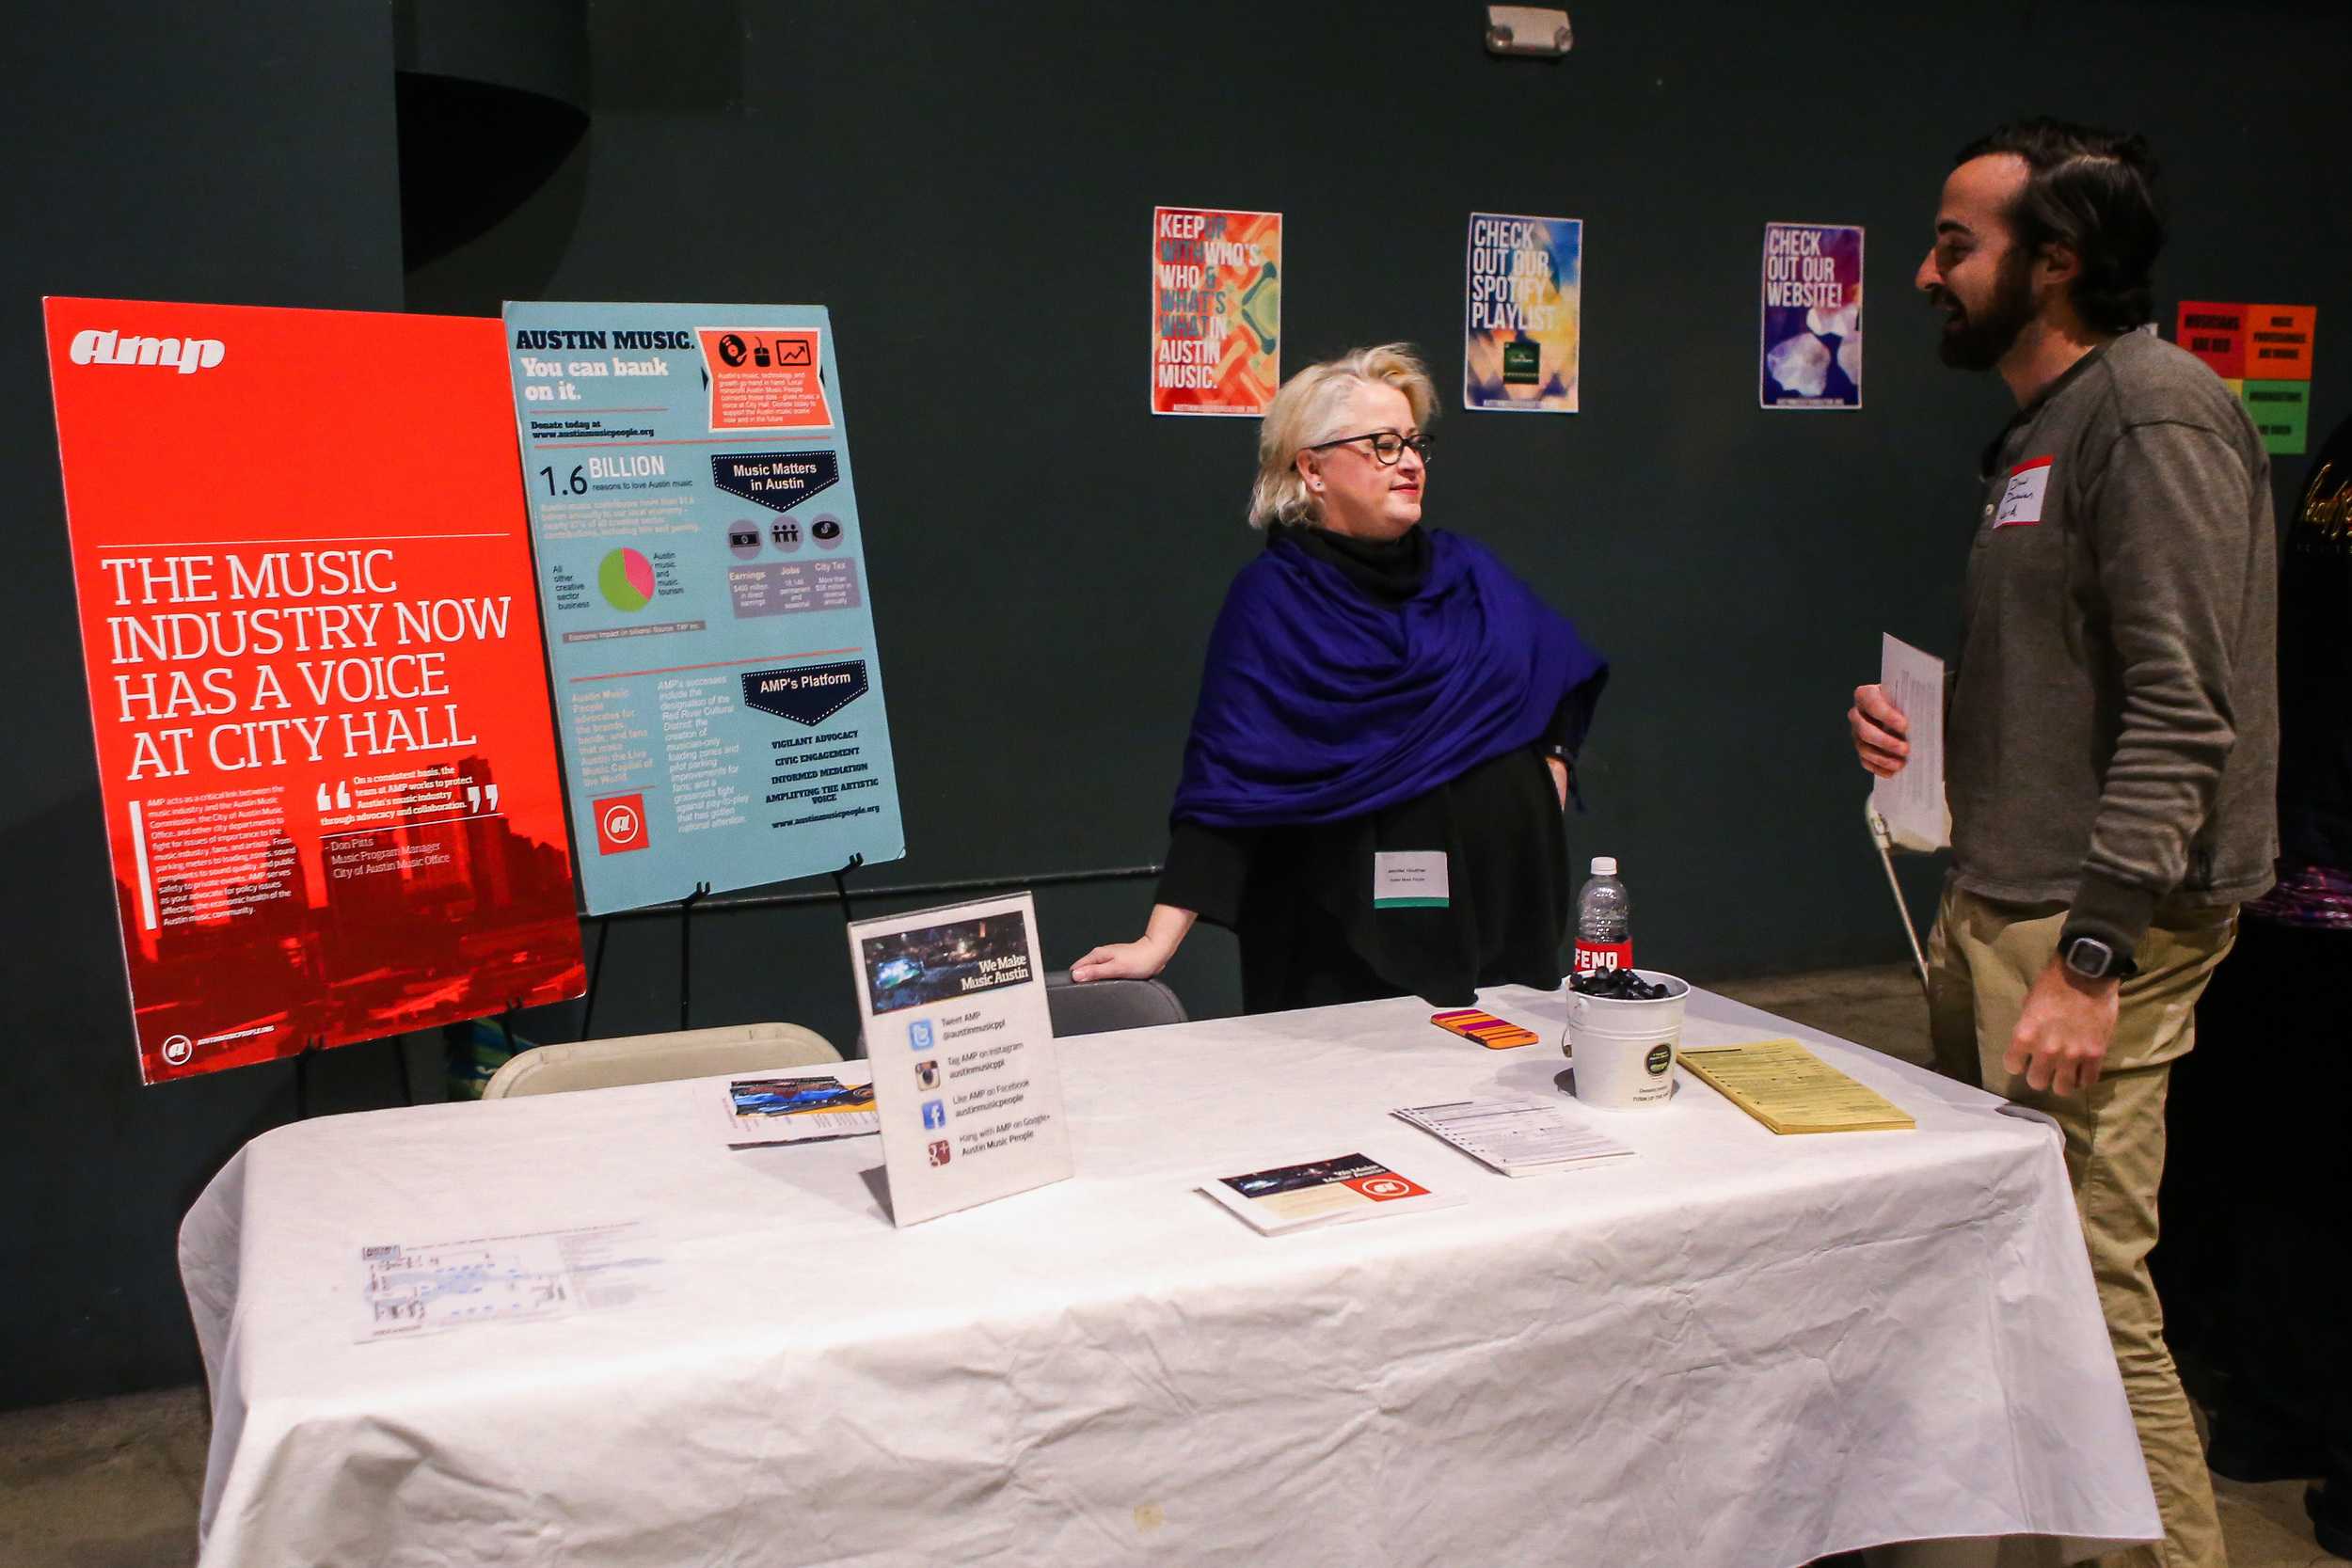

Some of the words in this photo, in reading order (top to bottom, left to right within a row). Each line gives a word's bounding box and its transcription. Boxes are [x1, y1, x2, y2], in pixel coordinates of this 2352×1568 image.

[1160, 214, 1204, 238] KEEP
[1205, 217, 1227, 235] UP
[1474, 220, 1535, 249] CHECK
[1161, 241, 1204, 263] WITH
[1205, 242, 1263, 267] WHO'S
[1769, 230, 1822, 256] CHECK
[1473, 247, 1508, 275] OUT
[1513, 251, 1550, 276] OUR
[1767, 257, 1799, 281] OUT
[1803, 257, 1835, 281] OUR
[1159, 265, 1200, 288] WHO
[1472, 276, 1546, 302] SPOTIFY
[1767, 283, 1842, 308] WEBSITE!
[1160, 290, 1226, 313] WHAT'S
[1160, 315, 1208, 337] WHAT
[1210, 317, 1228, 339] IN
[1472, 302, 1555, 331] PLAYLIST
[516, 330, 607, 349] AUSTIN
[613, 331, 694, 349] MUSIC.
[70, 329, 226, 374] amp
[1159, 341, 1220, 364] AUSTIN
[520, 357, 563, 377] You
[567, 361, 608, 377] can
[613, 357, 668, 377] bank
[1159, 364, 1217, 388] MUSIC.
[525, 384, 553, 401] on
[558, 381, 581, 401] it.
[531, 420, 562, 429] Donate
[564, 420, 591, 430] today
[540, 465, 587, 496] 1.6
[589, 455, 665, 478] BILLION
[733, 463, 770, 476] Music
[772, 461, 817, 475] Matters
[751, 478, 762, 490] in
[766, 477, 804, 490] Austin
[103, 557, 217, 606] THE
[226, 549, 397, 601] MUSIC
[729, 571, 767, 581] Earnings
[781, 566, 800, 575] Jobs
[659, 587, 684, 595] tourism
[558, 601, 589, 610] business
[107, 603, 385, 664] INDUSTRY
[393, 596, 512, 646] NOW
[115, 668, 237, 722] HAS
[250, 665, 291, 712] A
[297, 652, 449, 706] VOICE
[760, 678, 798, 693] AMP's
[802, 673, 851, 689] Platform
[127, 728, 194, 780] AT
[209, 715, 328, 771] CITY
[340, 705, 477, 757] HALL
[771, 736, 814, 749] VIGILANT
[815, 730, 858, 743] ADVOCACY
[775, 757, 799, 767] CIVIC
[801, 747, 860, 763] ENGAGEMENT
[354, 776, 363, 784] On
[373, 771, 416, 783] consistent
[771, 771, 818, 784] INFORMED
[819, 763, 867, 777] MEDIATION
[356, 788, 376, 797] team
[389, 784, 407, 792] AMP
[409, 781, 435, 790] works
[445, 777, 472, 788] protect
[766, 788, 819, 803] AMPLIFYING
[821, 784, 838, 793] THE
[841, 779, 879, 791] ARTISTIC
[358, 800, 391, 809] Austin's
[392, 795, 417, 805] music
[418, 791, 452, 803] industry
[812, 794, 836, 804] VOICE
[321, 816, 355, 825] through
[357, 811, 395, 822] advocacy
[397, 808, 411, 816] and
[331, 841, 351, 850] Don
[352, 838, 373, 847] Pitts
[332, 854, 359, 864] Music
[361, 848, 399, 862] Program
[401, 842, 440, 855] Manager
[334, 868, 352, 879] City
[355, 866, 364, 876] of
[366, 863, 396, 874] Austin
[398, 859, 423, 869] Music
[425, 854, 451, 864] Office
[979, 959, 996, 973] We
[997, 955, 1026, 969] Make
[961, 974, 993, 990] Music
[994, 967, 1028, 983] Austin
[942, 1017, 961, 1026] Tweet
[965, 1012, 980, 1021] AMP
[948, 1057, 960, 1066] Tag
[962, 1053, 977, 1061] AMP
[990, 1043, 1024, 1054] Instagram
[953, 1095, 967, 1104] Like
[969, 1090, 985, 1100] AMP
[996, 1081, 1028, 1093] Facebook
[960, 1133, 978, 1142] Hang
[979, 1128, 994, 1137] with
[996, 1123, 1011, 1132] AMP
[962, 1145, 986, 1156] Austin
[987, 1138, 1008, 1148] Music
[1009, 1131, 1034, 1142] People
